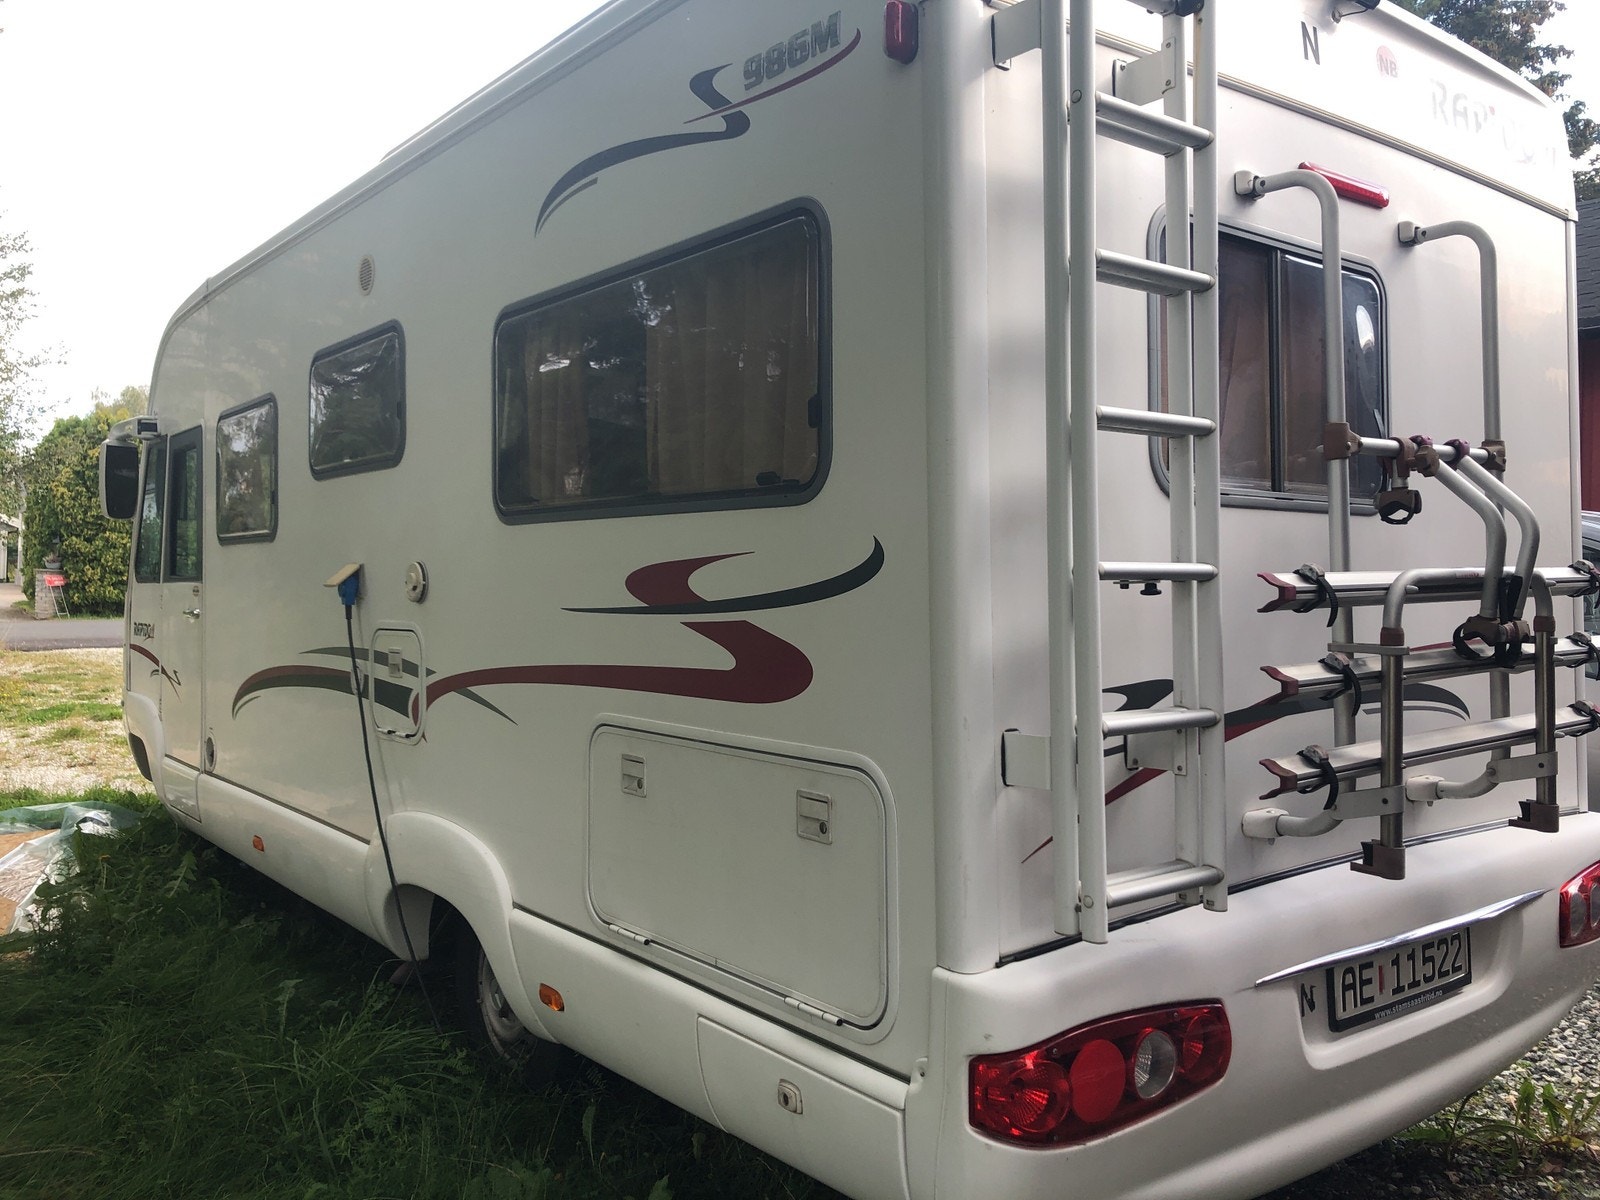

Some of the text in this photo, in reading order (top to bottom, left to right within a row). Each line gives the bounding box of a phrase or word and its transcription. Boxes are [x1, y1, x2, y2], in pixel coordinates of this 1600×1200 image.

[742, 10, 842, 91] 986M
[1300, 21, 1321, 65] N
[1378, 54, 1398, 78] NB
[1430, 78, 1557, 167] RAP
[1300, 982, 1317, 1017] N
[1341, 932, 1463, 1012] AE 11522
